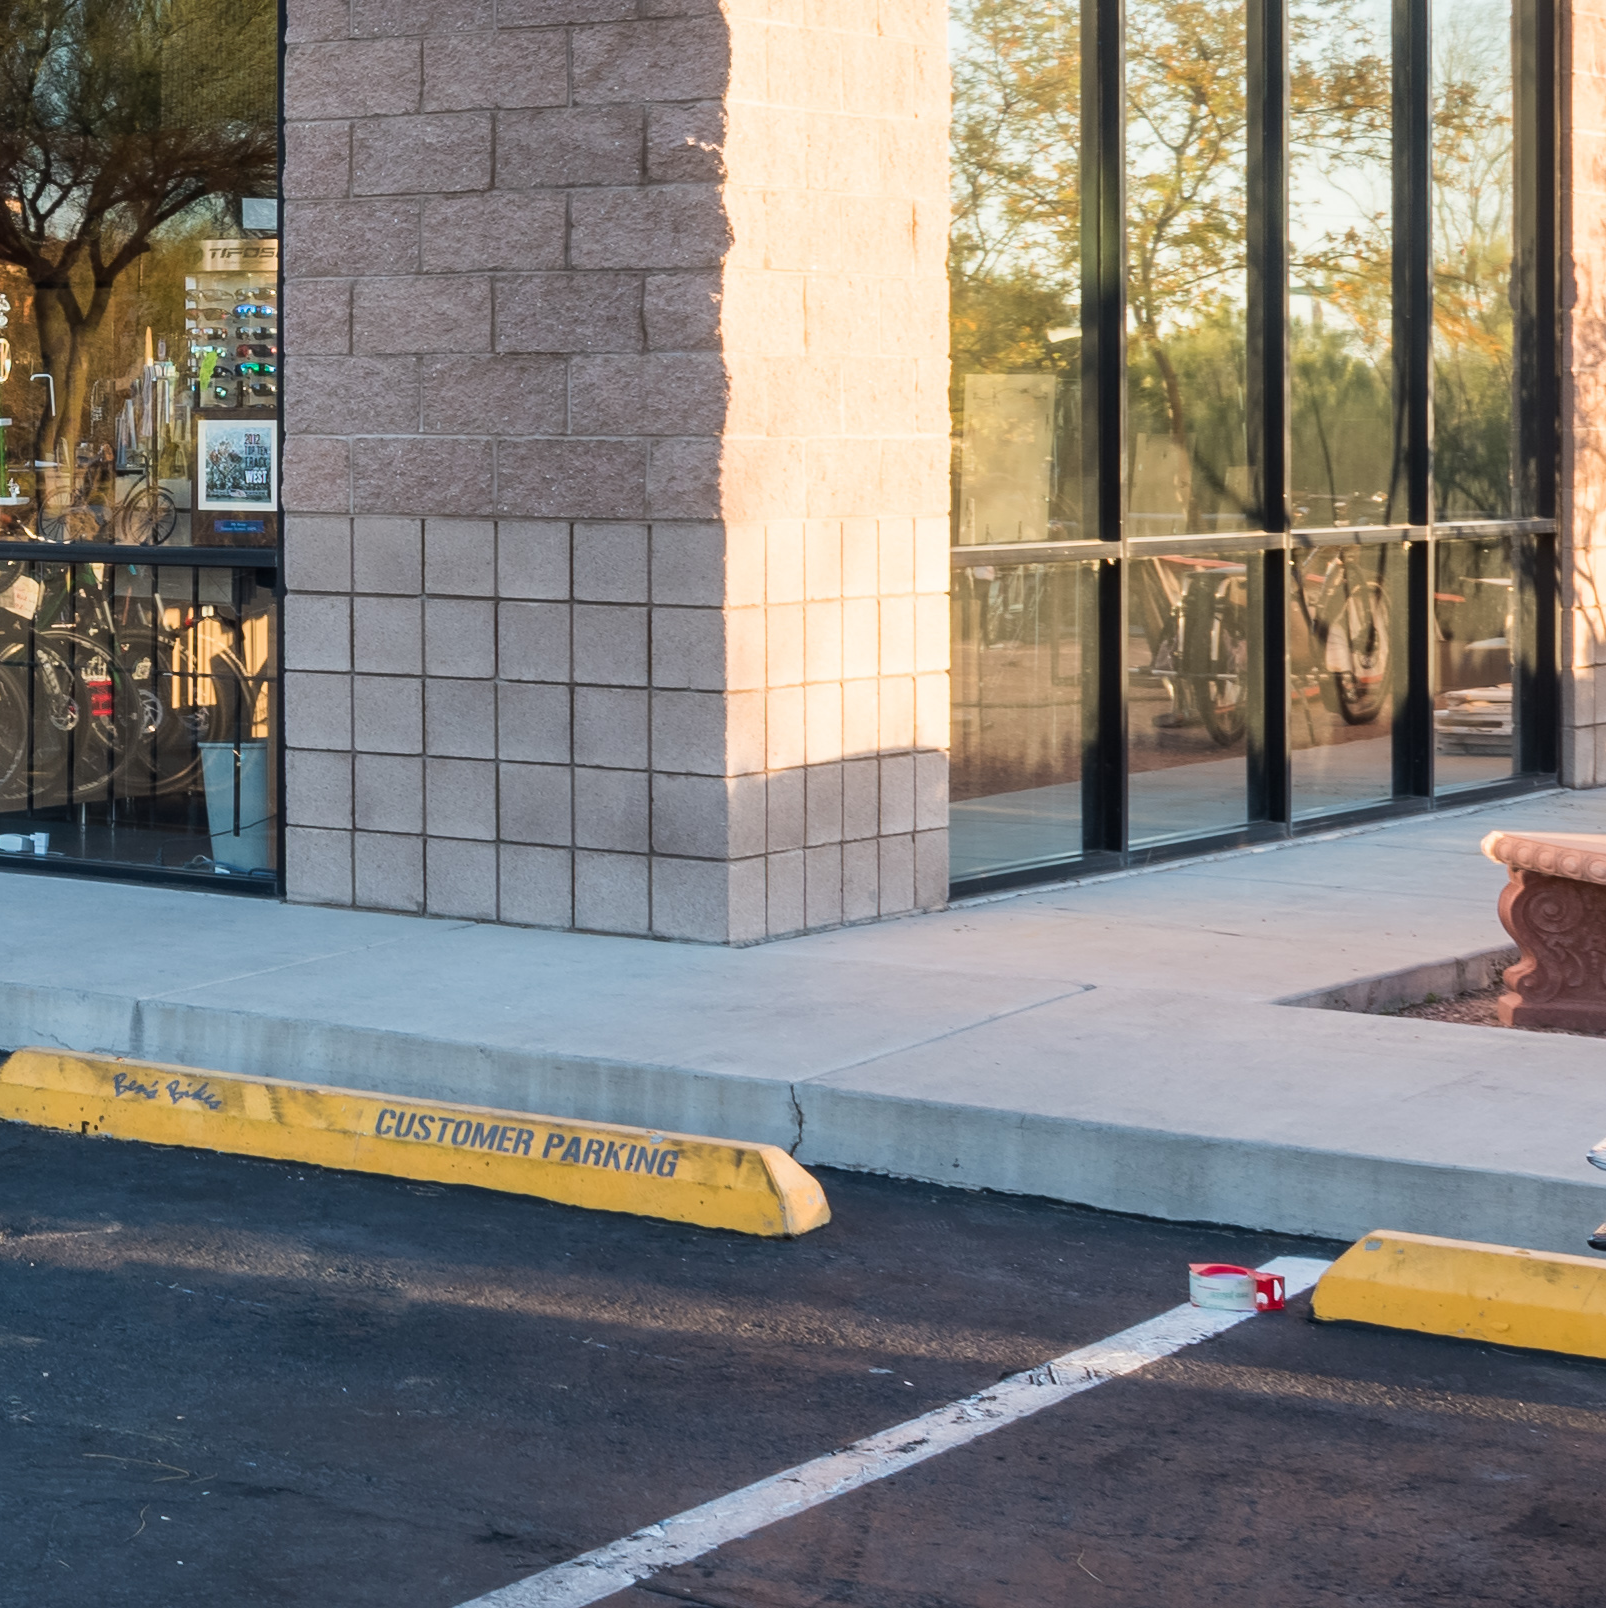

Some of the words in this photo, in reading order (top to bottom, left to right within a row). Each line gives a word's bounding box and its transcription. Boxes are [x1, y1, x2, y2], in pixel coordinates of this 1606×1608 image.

[209, 247, 277, 259] TIFOS
[244, 433, 260, 445] 2012
[245, 471, 268, 484] WEST
[112, 1073, 159, 1099] Ben's
[166, 1079, 222, 1110] Bikes
[375, 1108, 536, 1156] CUSTOMER
[541, 1132, 680, 1178] PARKING
